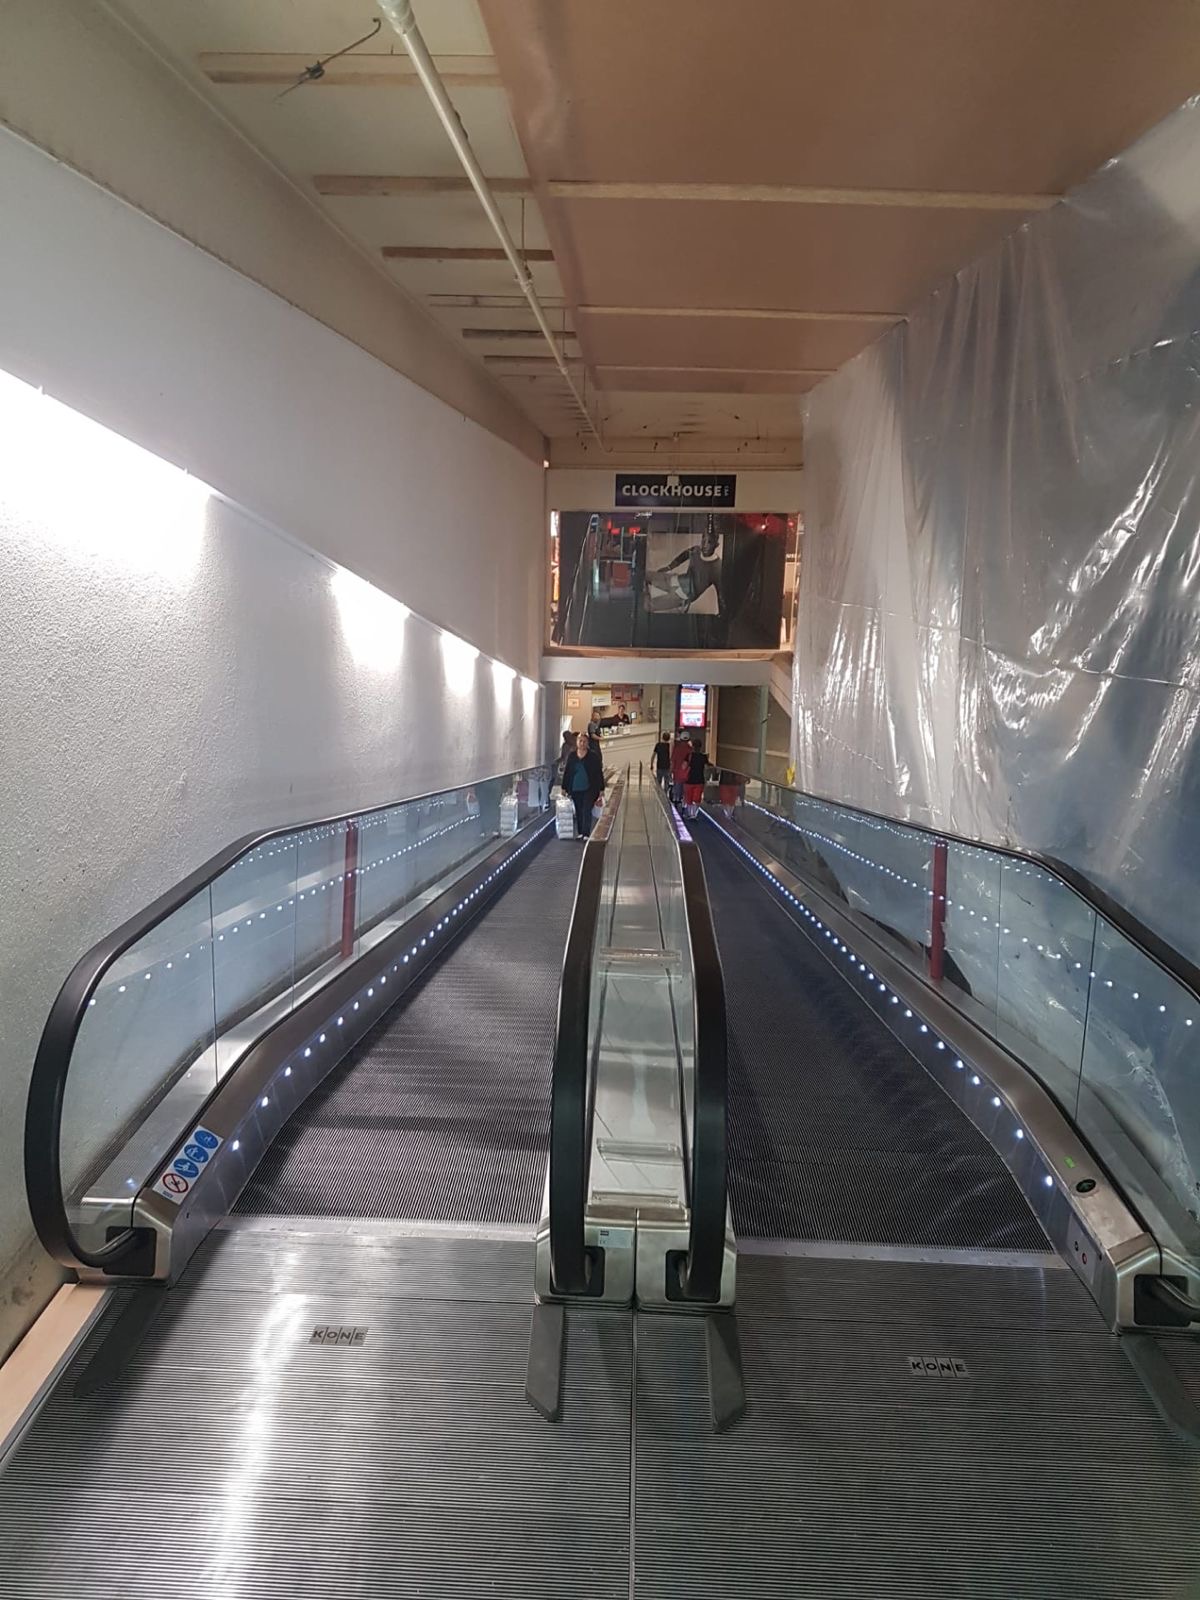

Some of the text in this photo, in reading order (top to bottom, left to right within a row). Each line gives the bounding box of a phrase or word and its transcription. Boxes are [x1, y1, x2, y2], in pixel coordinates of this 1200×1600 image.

[622, 484, 722, 497] CLOCKHOUSE
[312, 1329, 366, 1341] KONE
[910, 1360, 966, 1374] KONE
